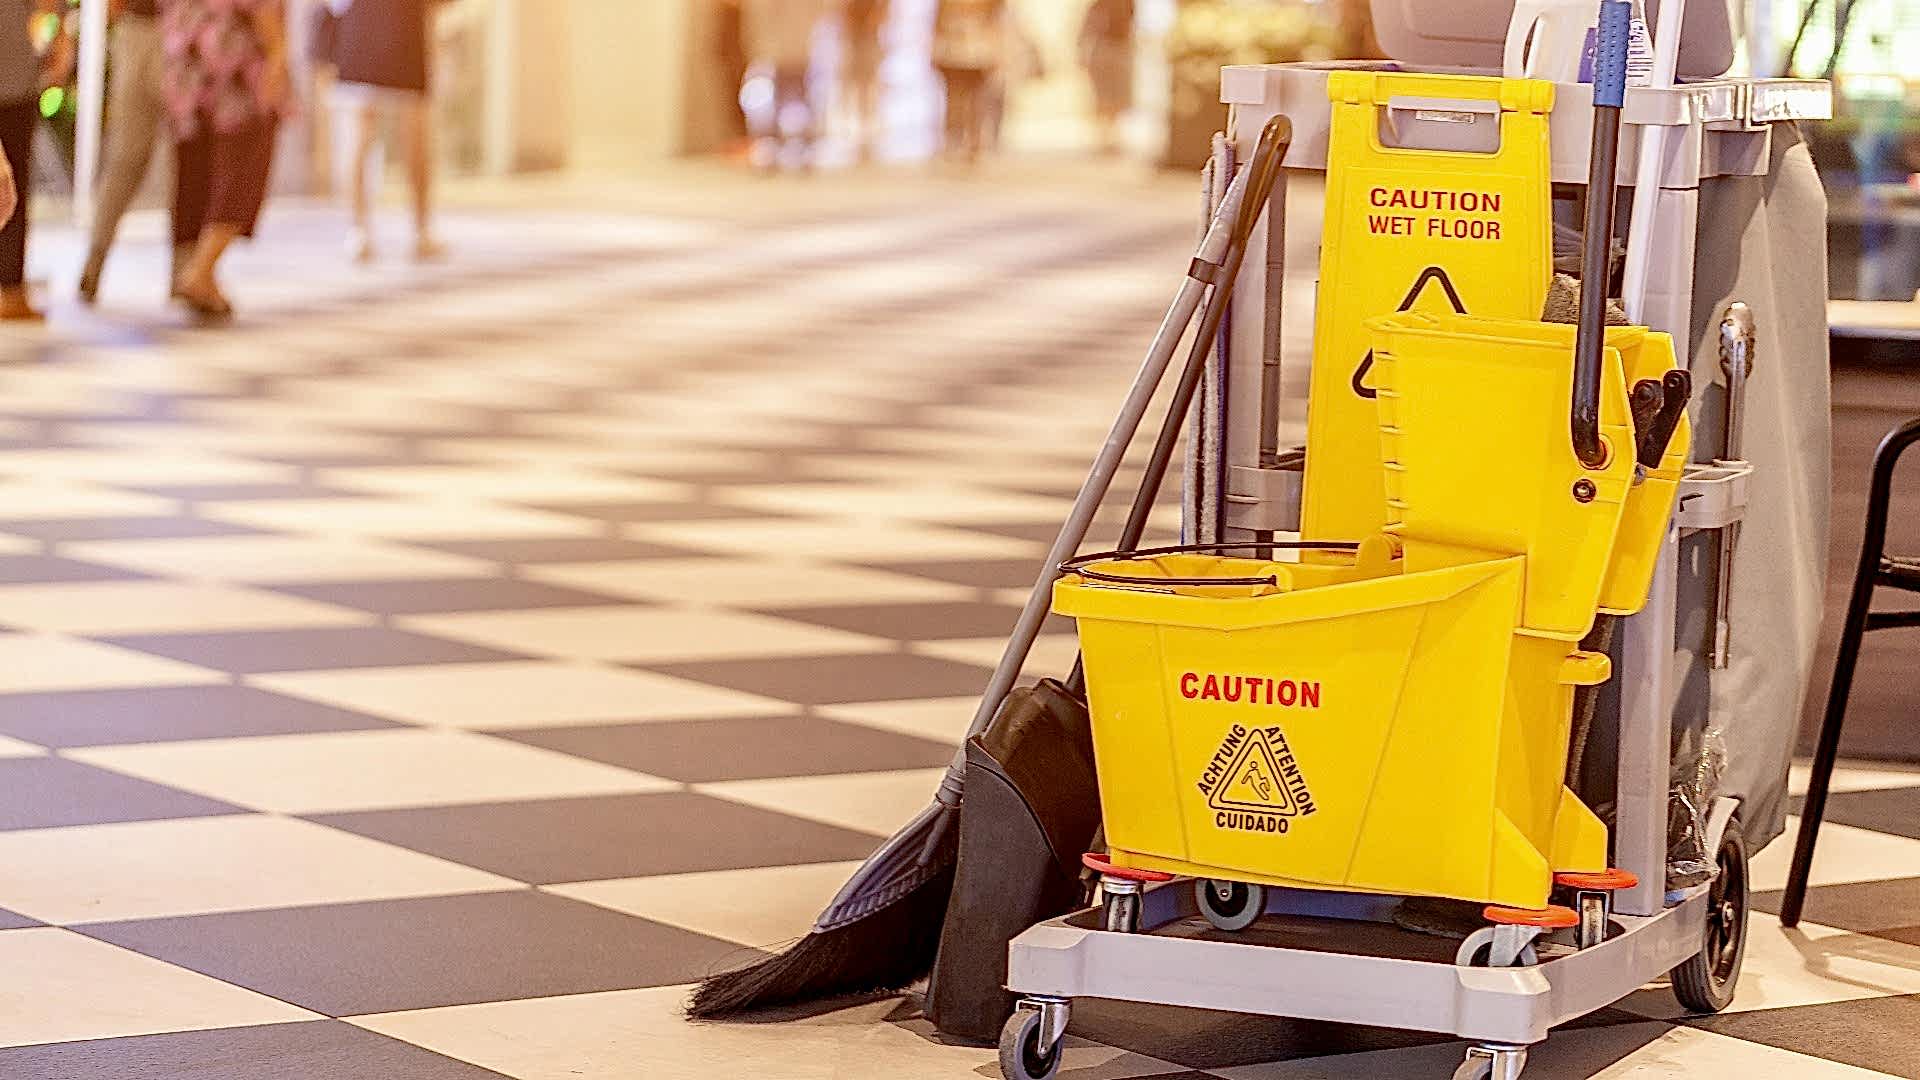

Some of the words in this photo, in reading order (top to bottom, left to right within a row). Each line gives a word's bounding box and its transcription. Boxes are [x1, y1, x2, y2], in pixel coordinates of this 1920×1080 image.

[1370, 188, 1501, 212] CAUTION
[1369, 215, 1416, 235] WET
[1428, 218, 1500, 240] FLOOR
[1181, 672, 1320, 708] CAUTION
[1197, 724, 1246, 796] ACHTUNG
[1265, 726, 1317, 816] ATTENTION
[1216, 812, 1289, 834] CUIDADO
